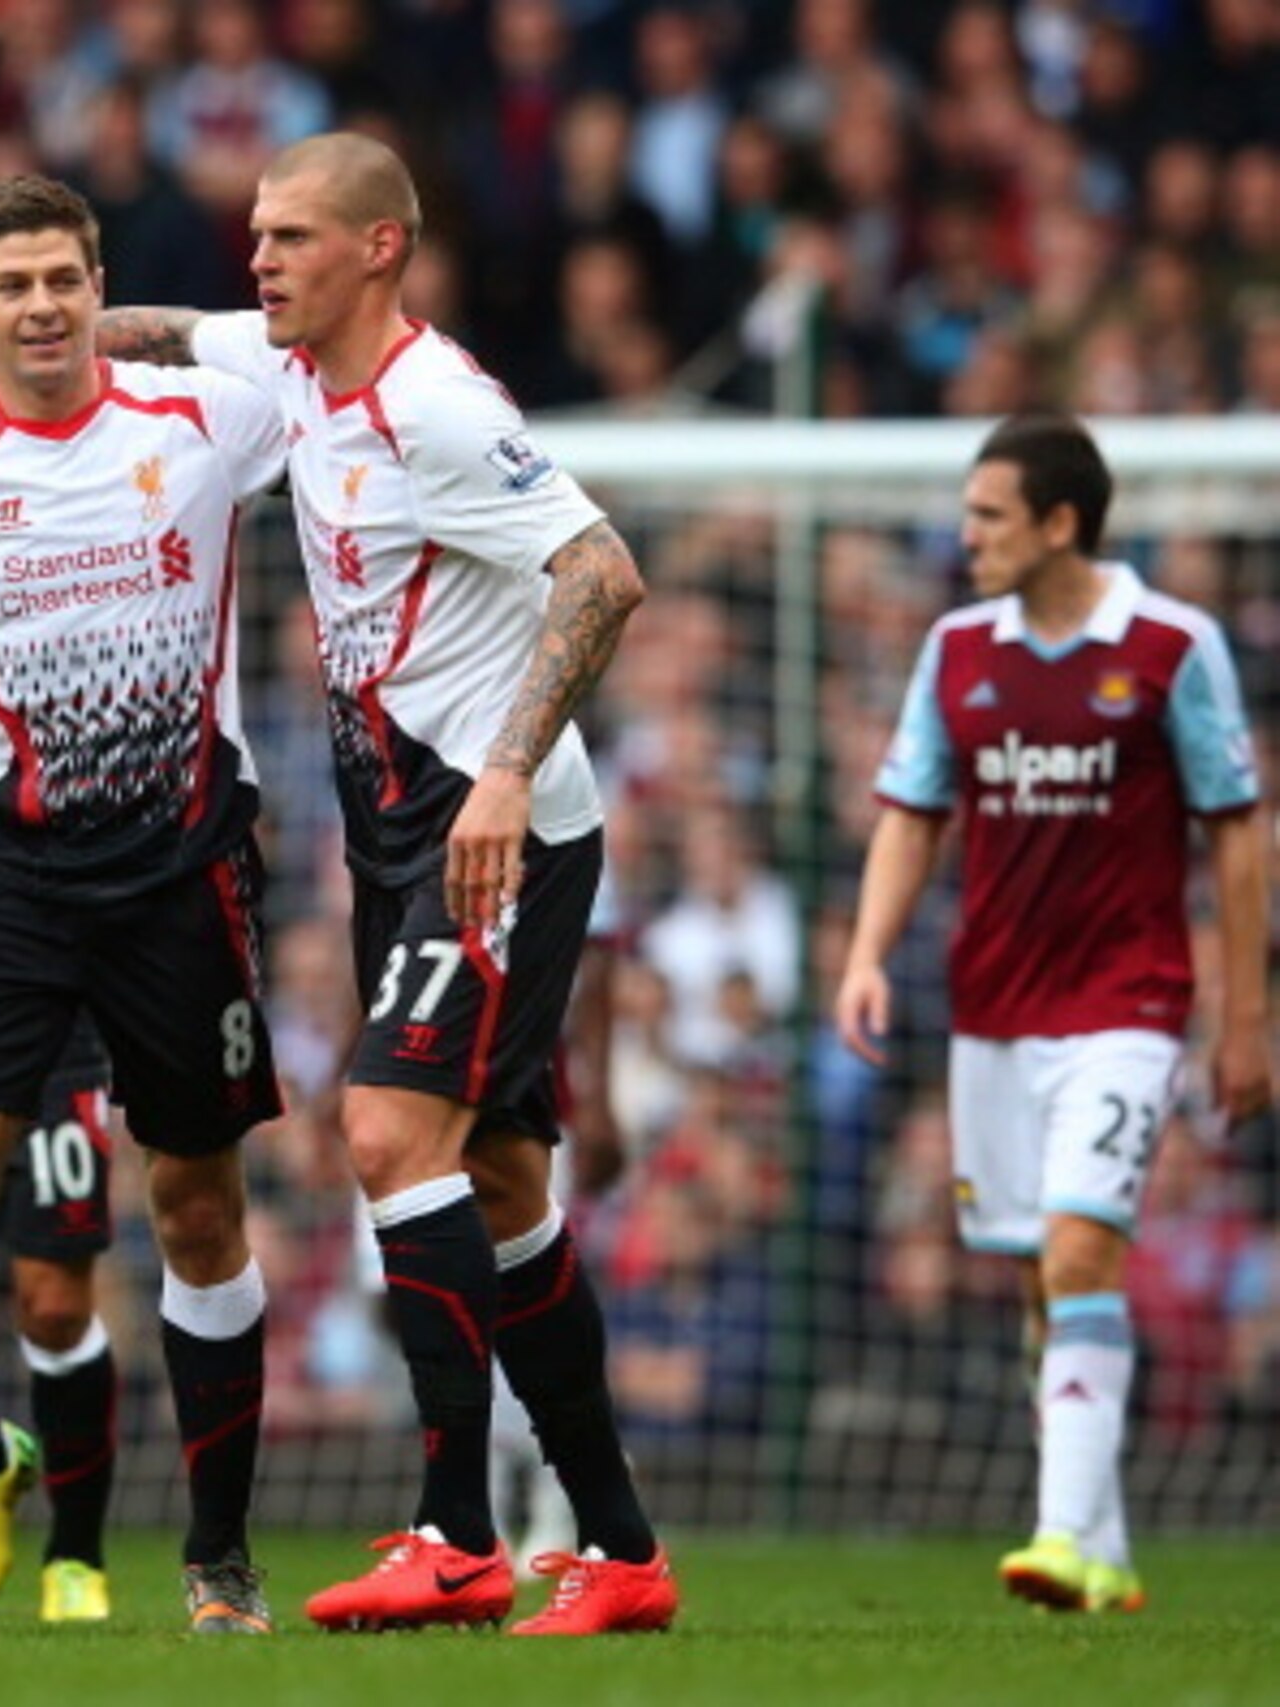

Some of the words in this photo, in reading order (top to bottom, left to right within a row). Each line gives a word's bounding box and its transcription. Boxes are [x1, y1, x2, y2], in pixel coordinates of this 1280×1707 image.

[0, 567, 154, 617] Chartered
[3, 536, 148, 583] Standard
[976, 730, 1115, 797] alpari
[370, 940, 463, 1021] 37
[220, 1000, 254, 1077] 8
[29, 1121, 94, 1206] 10
[1092, 1092, 1156, 1168] 23
